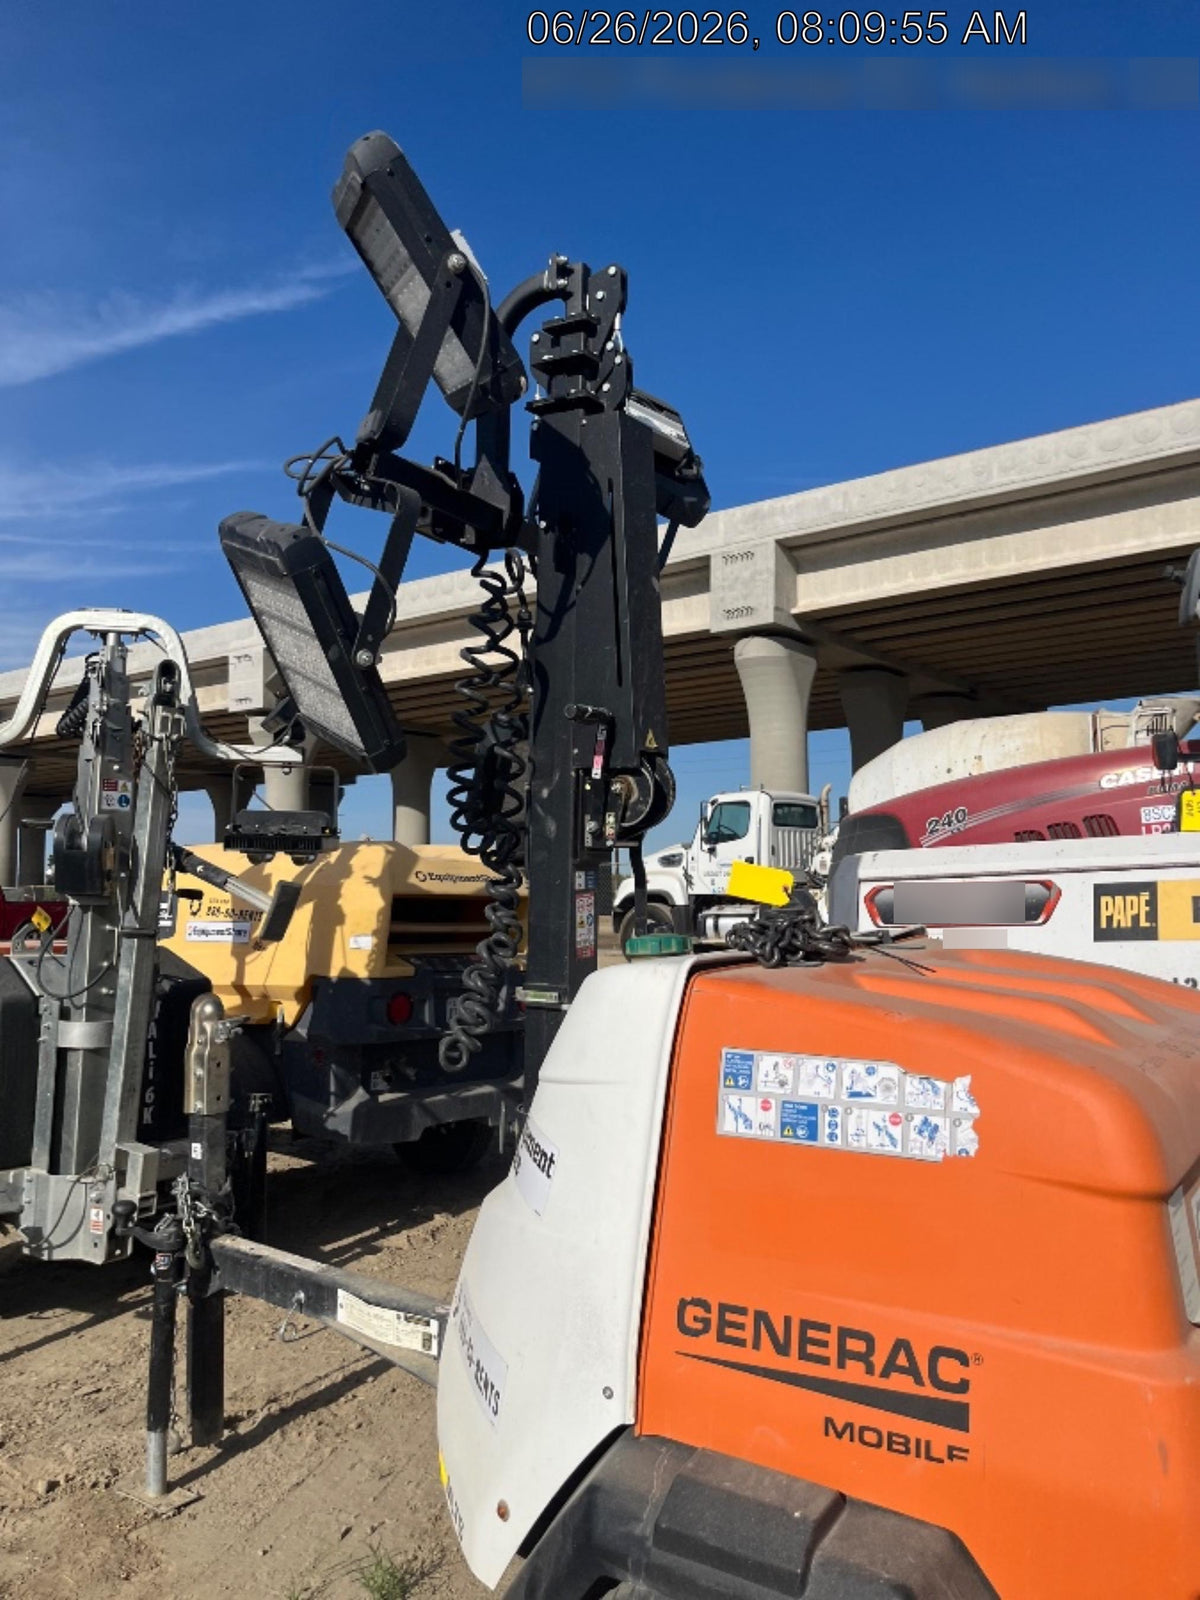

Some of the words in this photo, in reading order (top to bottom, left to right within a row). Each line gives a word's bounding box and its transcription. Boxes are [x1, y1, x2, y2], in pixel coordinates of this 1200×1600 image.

[1100, 764, 1166, 788] CASE
[926, 806, 968, 835] 240
[676, 1296, 971, 1395] GENERAC
